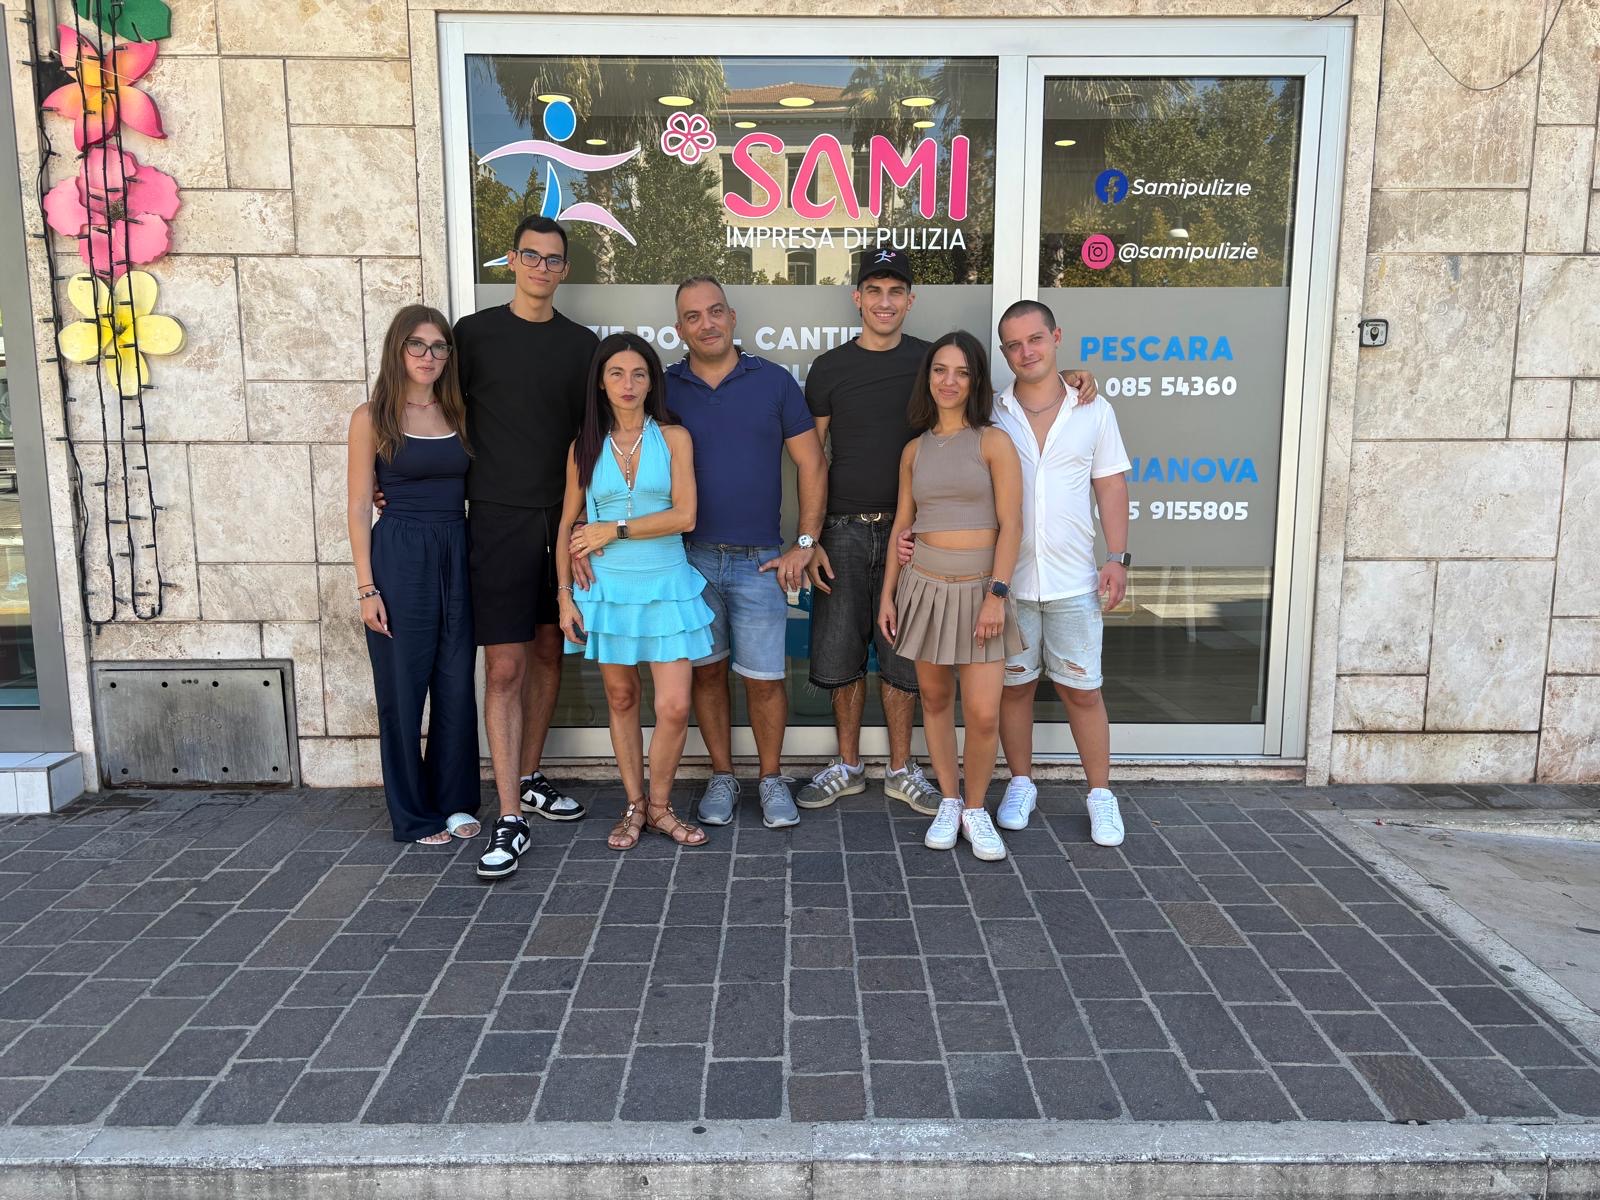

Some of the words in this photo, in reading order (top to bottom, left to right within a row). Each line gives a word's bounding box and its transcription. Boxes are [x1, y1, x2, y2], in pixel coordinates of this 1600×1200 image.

[723, 132, 969, 221] SAMI
[726, 226, 834, 249] IMPRESA
[843, 227, 867, 249] DI
[876, 228, 967, 250] PULIZIA
[1118, 242, 1259, 263] @samipulizie
[1080, 336, 1233, 361] PESCARA
[1105, 377, 1152, 397] 085
[1160, 376, 1237, 397] 54360
[1125, 457, 1259, 483] IANOVA
[1149, 501, 1249, 521] 9155805
